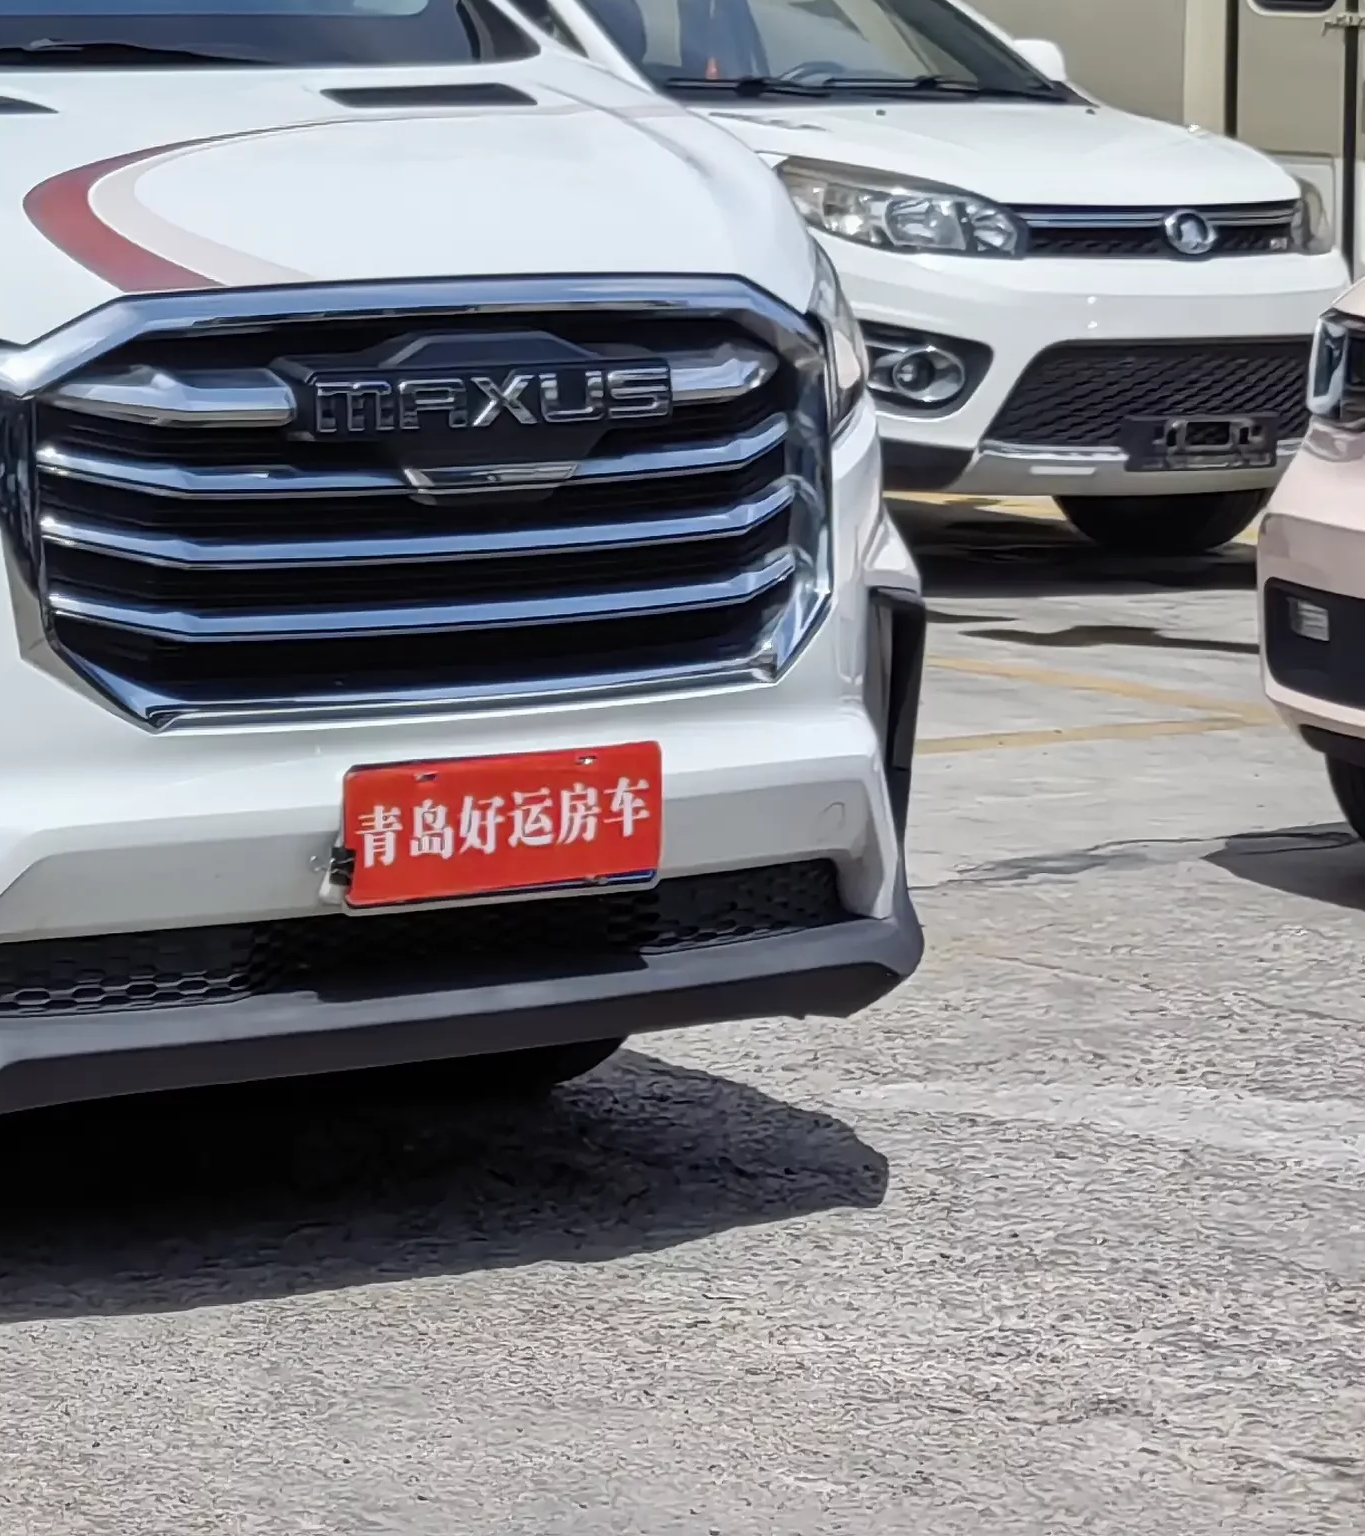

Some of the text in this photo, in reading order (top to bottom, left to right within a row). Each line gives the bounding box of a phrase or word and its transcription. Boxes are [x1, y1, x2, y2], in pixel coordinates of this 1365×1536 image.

[315, 366, 670, 433] MAXUS
[355, 776, 651, 869] 青岛好运房车
